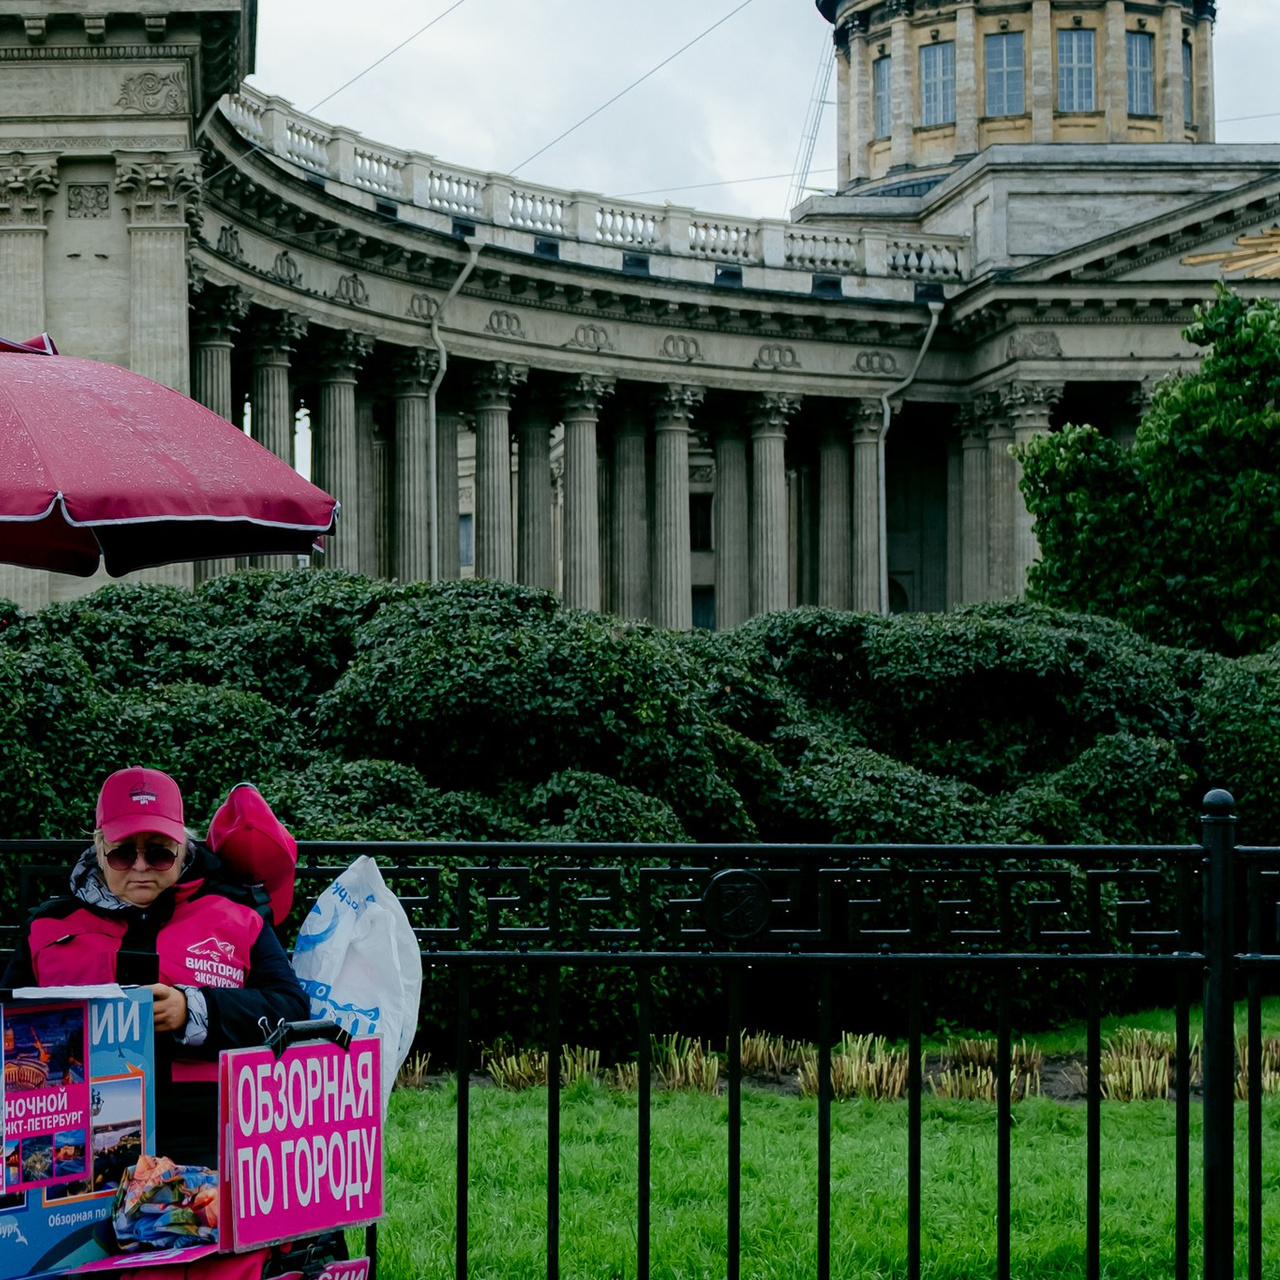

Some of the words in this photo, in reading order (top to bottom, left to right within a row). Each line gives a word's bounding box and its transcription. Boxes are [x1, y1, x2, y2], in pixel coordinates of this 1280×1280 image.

[5, 1087, 68, 1119] НОЧНОЙ
[238, 1051, 373, 1137] ОБЗОРНАЯ
[237, 1143, 275, 1218] ПО
[281, 1126, 377, 1211] ГОРОДУ
[48, 1210, 93, 1228] Обзорная
[95, 1208, 106, 1218] по
